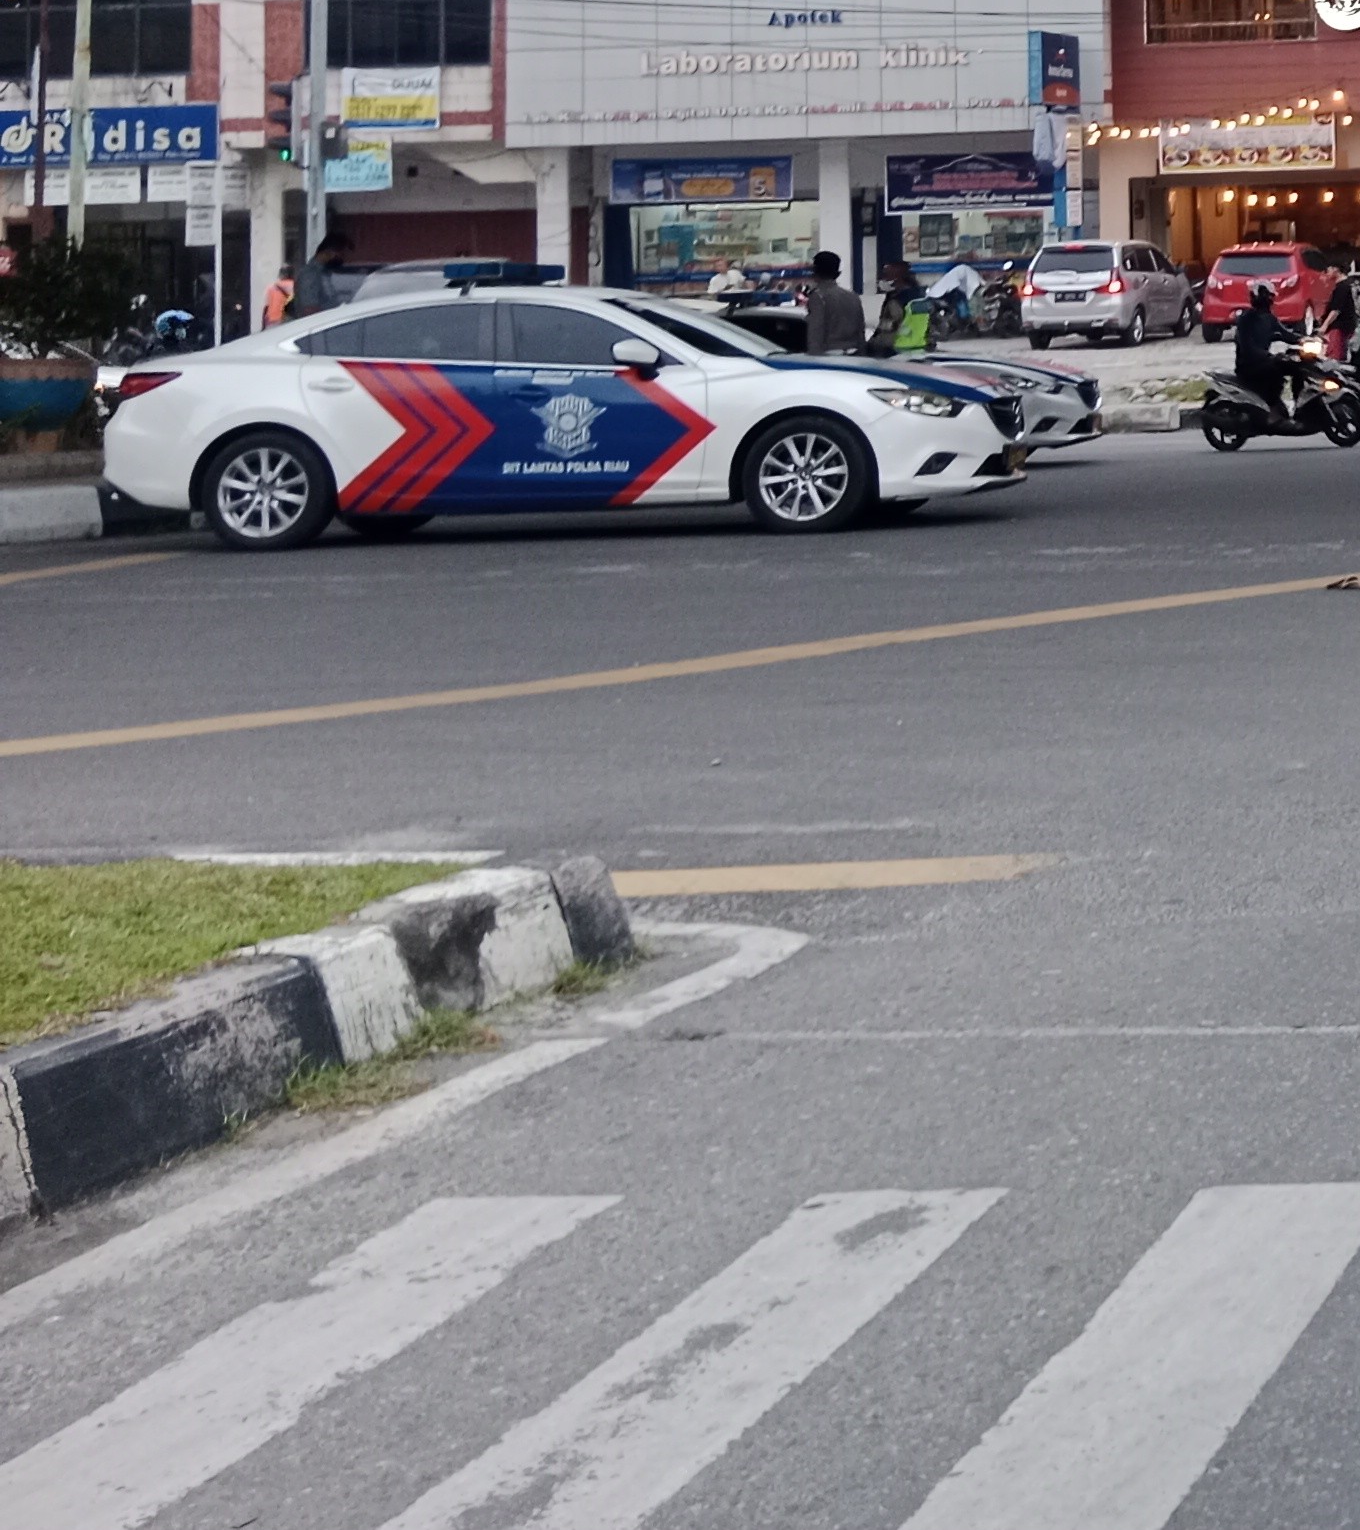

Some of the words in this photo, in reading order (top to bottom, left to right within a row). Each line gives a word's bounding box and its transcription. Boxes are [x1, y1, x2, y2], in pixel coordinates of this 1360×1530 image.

[767, 10, 843, 29] Apotek
[639, 47, 859, 78] Laboratorium
[43, 118, 202, 155] Rdisa
[523, 461, 565, 474] LANTAS
[566, 460, 602, 473] POLDA
[603, 459, 630, 472] RIAU
